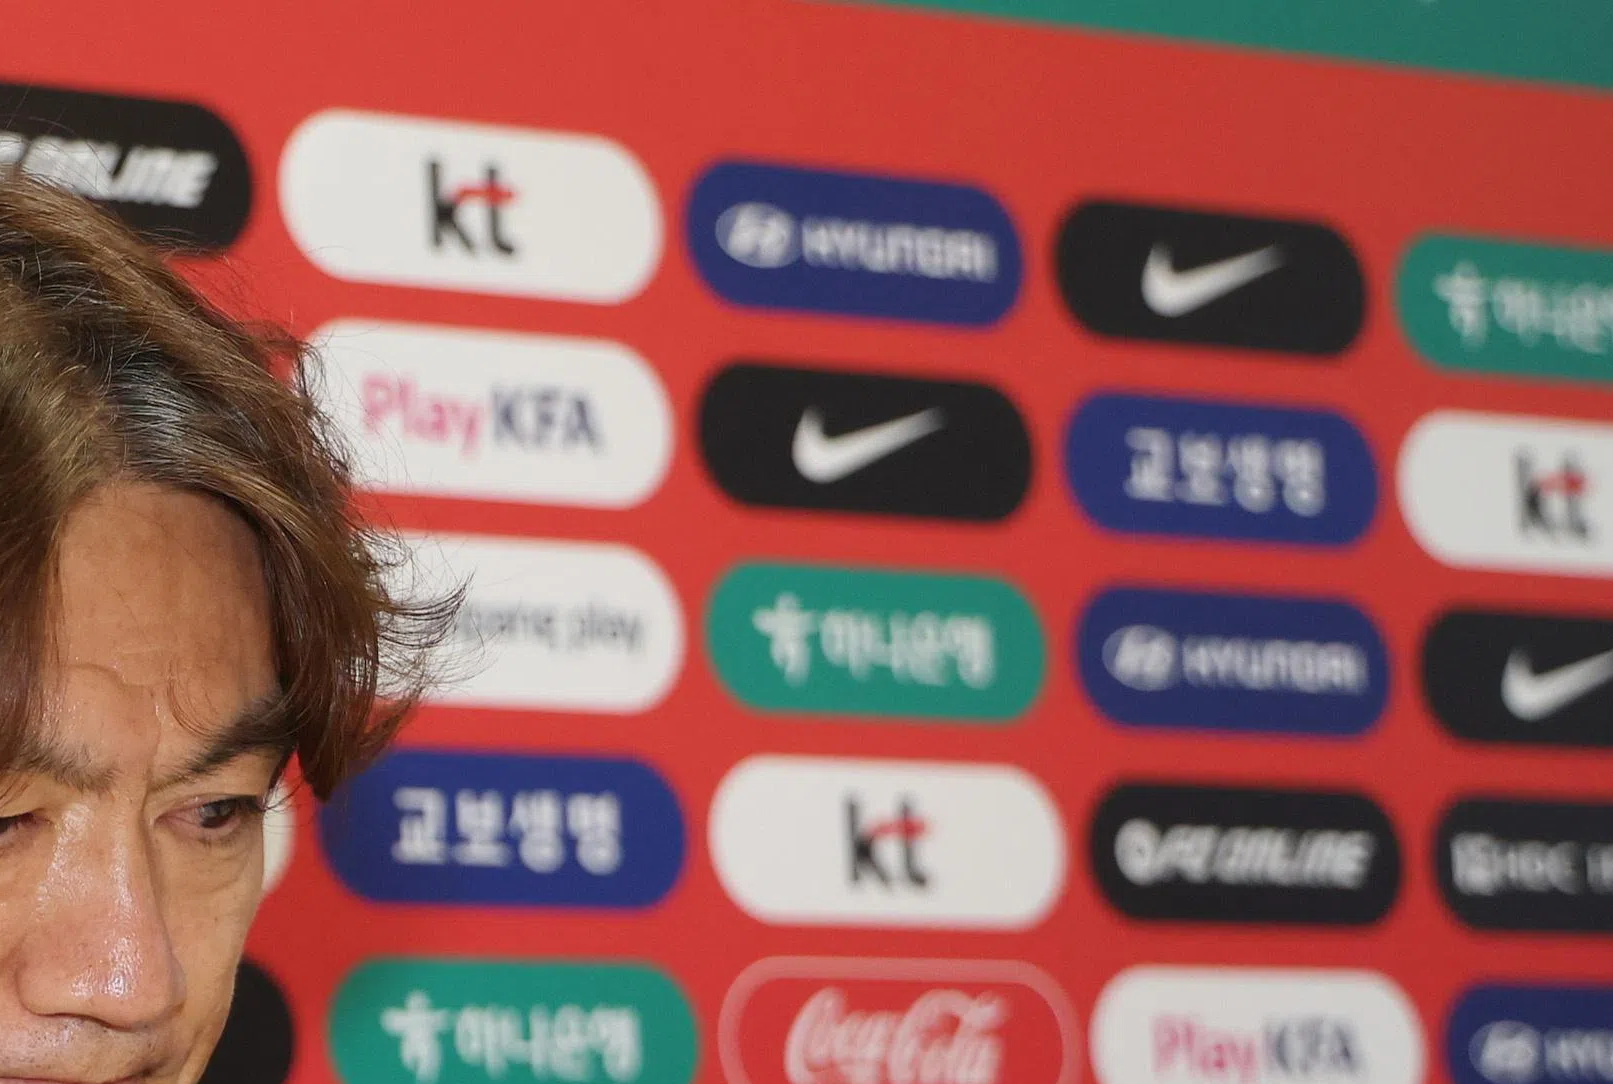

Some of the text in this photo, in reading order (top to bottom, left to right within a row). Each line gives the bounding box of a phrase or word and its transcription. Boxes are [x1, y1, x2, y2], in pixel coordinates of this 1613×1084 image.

[422, 155, 522, 260] kt
[1512, 446, 1595, 542] kt
[393, 787, 621, 874] 교보생명
[843, 793, 933, 890] kt
